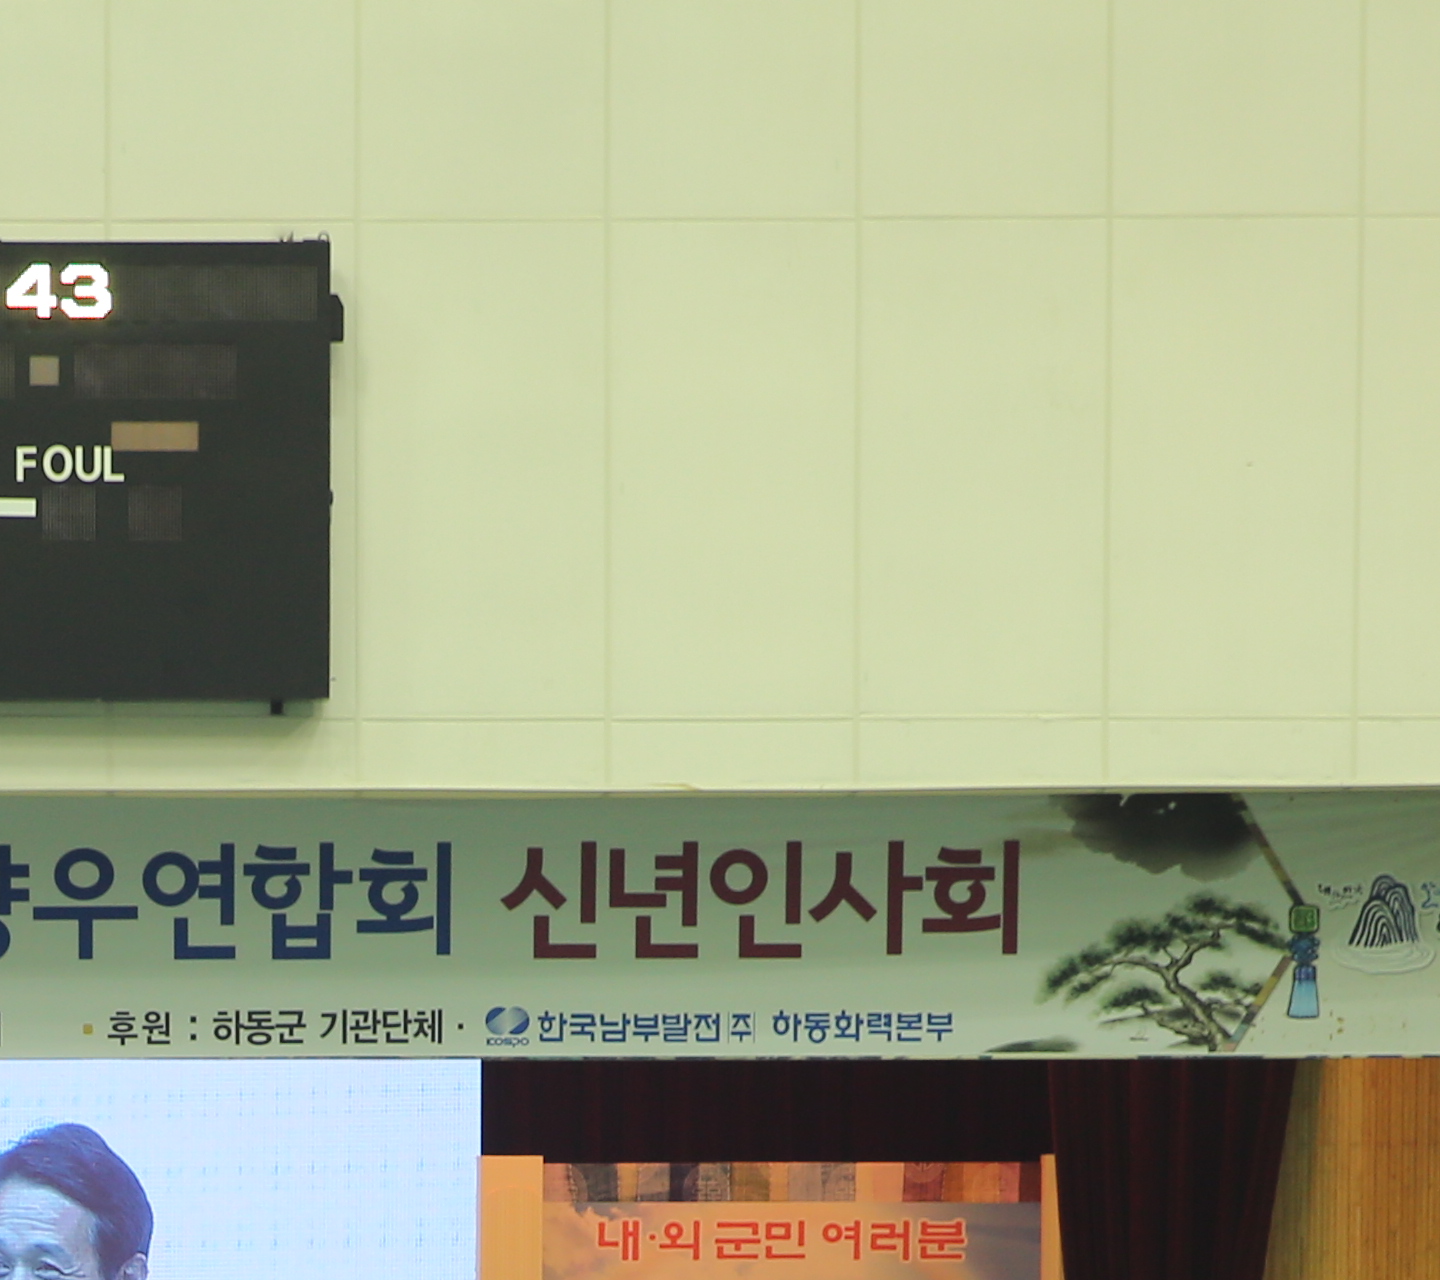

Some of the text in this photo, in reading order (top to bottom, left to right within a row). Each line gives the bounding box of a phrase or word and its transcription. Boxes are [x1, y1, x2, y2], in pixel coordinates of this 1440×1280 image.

[16, 445, 125, 483] FOUL
[500, 839, 1021, 960] 신년인사회
[105, 1010, 172, 1048] 후원
[211, 1008, 308, 1048] 하동군
[319, 1007, 444, 1047] 기관단체
[771, 1009, 954, 1044] 하동화력본부
[713, 1220, 807, 1261] 군민
[821, 1219, 967, 1262] 여러분
